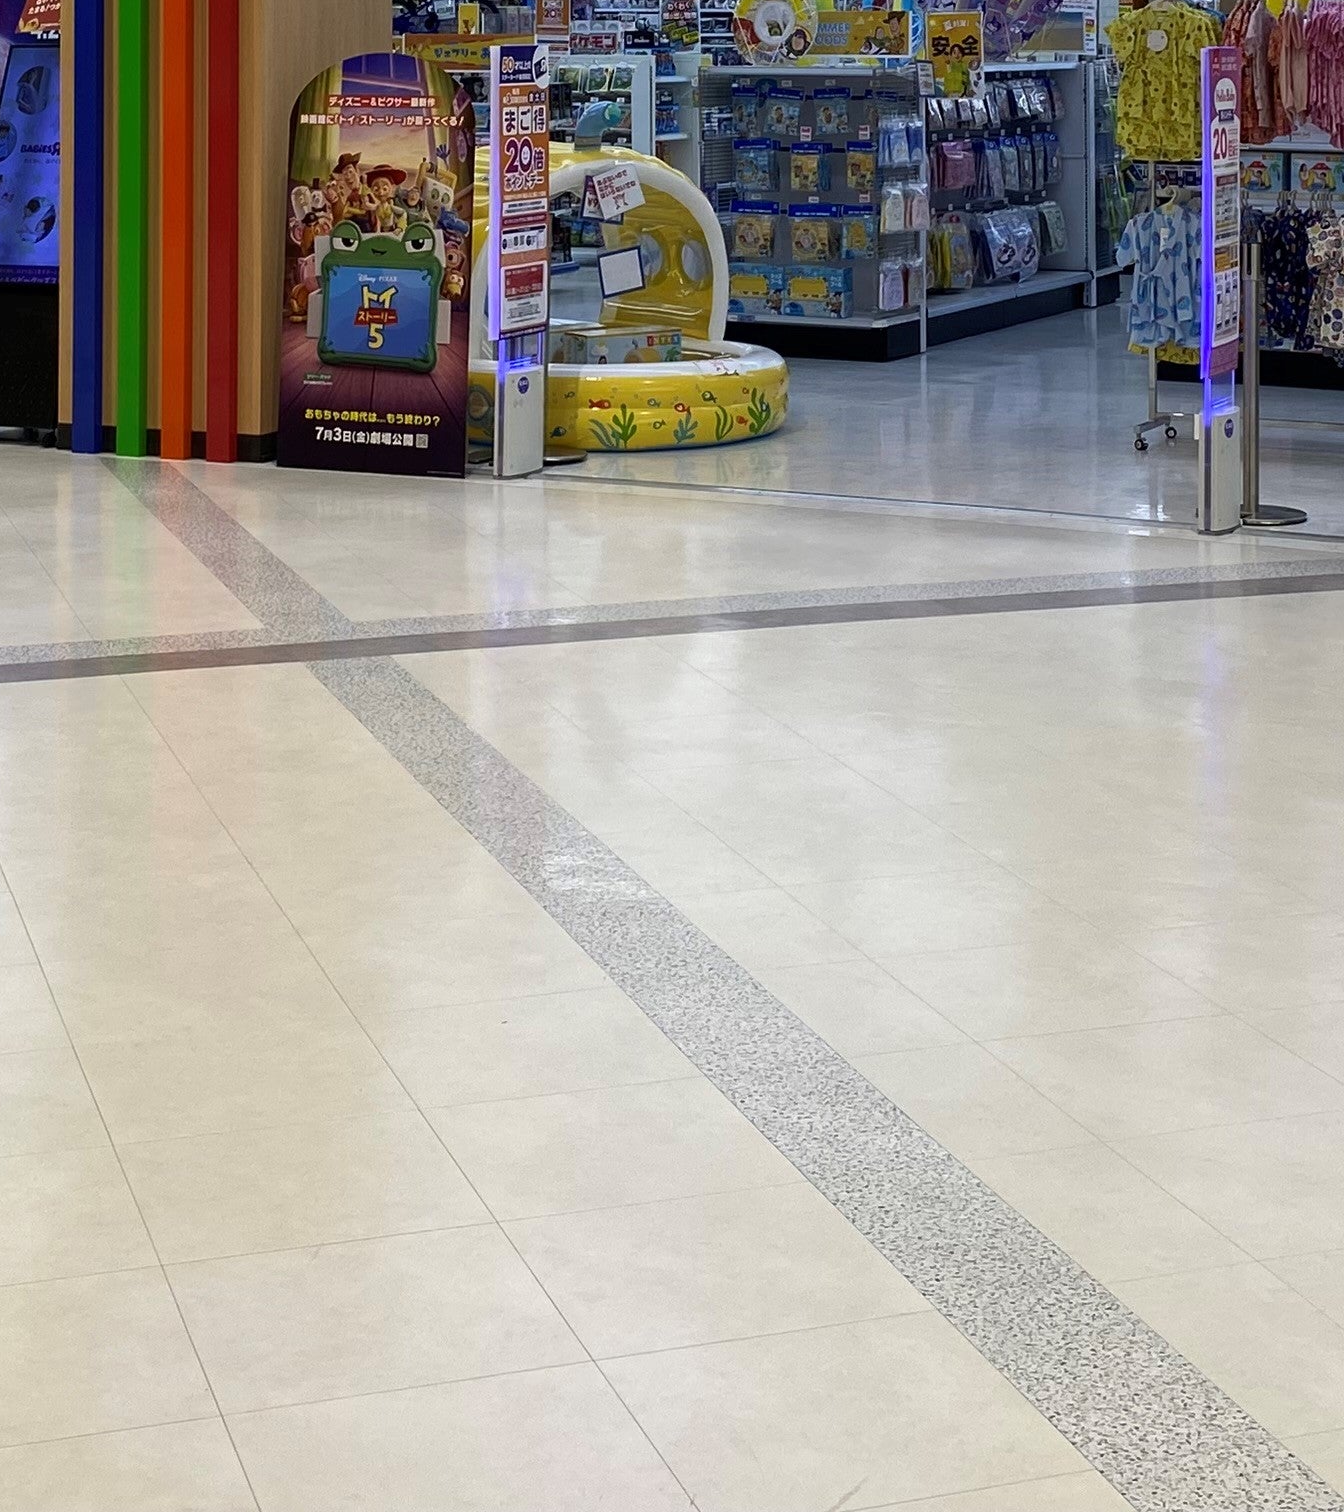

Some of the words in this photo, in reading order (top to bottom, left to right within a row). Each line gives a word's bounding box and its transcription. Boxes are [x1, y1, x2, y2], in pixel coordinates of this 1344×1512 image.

[932, 33, 979, 58] 安全
[503, 105, 546, 136] まご得
[504, 136, 545, 174] 20倍
[504, 173, 544, 191] ポイントデー
[358, 274, 376, 284] Disney
[361, 285, 398, 309] トイ
[358, 311, 397, 322] ストーリー
[368, 323, 385, 349] 5
[315, 426, 414, 447] 7月3日(金)劇場公開
